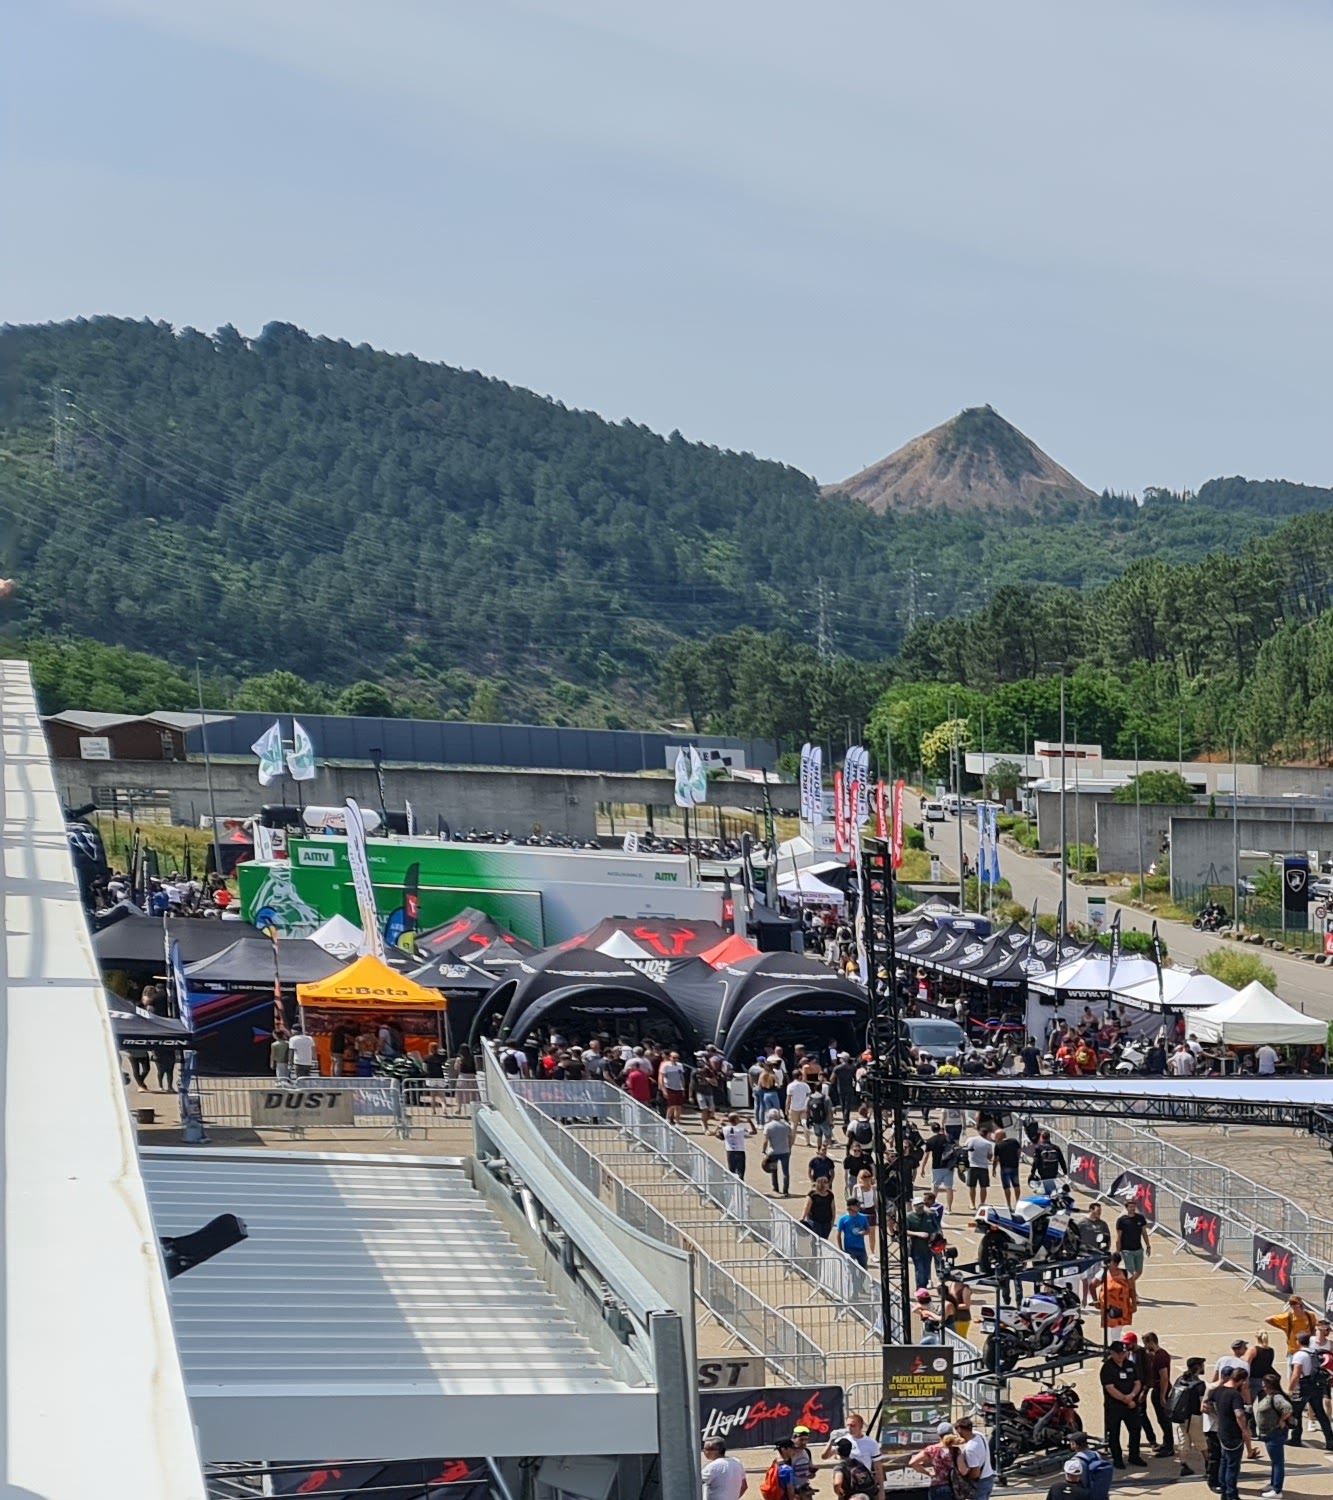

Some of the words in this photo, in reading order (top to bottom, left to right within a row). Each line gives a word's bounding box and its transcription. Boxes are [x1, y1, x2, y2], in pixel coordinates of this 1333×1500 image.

[304, 852, 329, 862] AMV
[654, 872, 678, 882] AMV
[355, 987, 409, 997] Beta
[264, 1092, 342, 1109] DUST
[698, 1362, 749, 1388] ST
